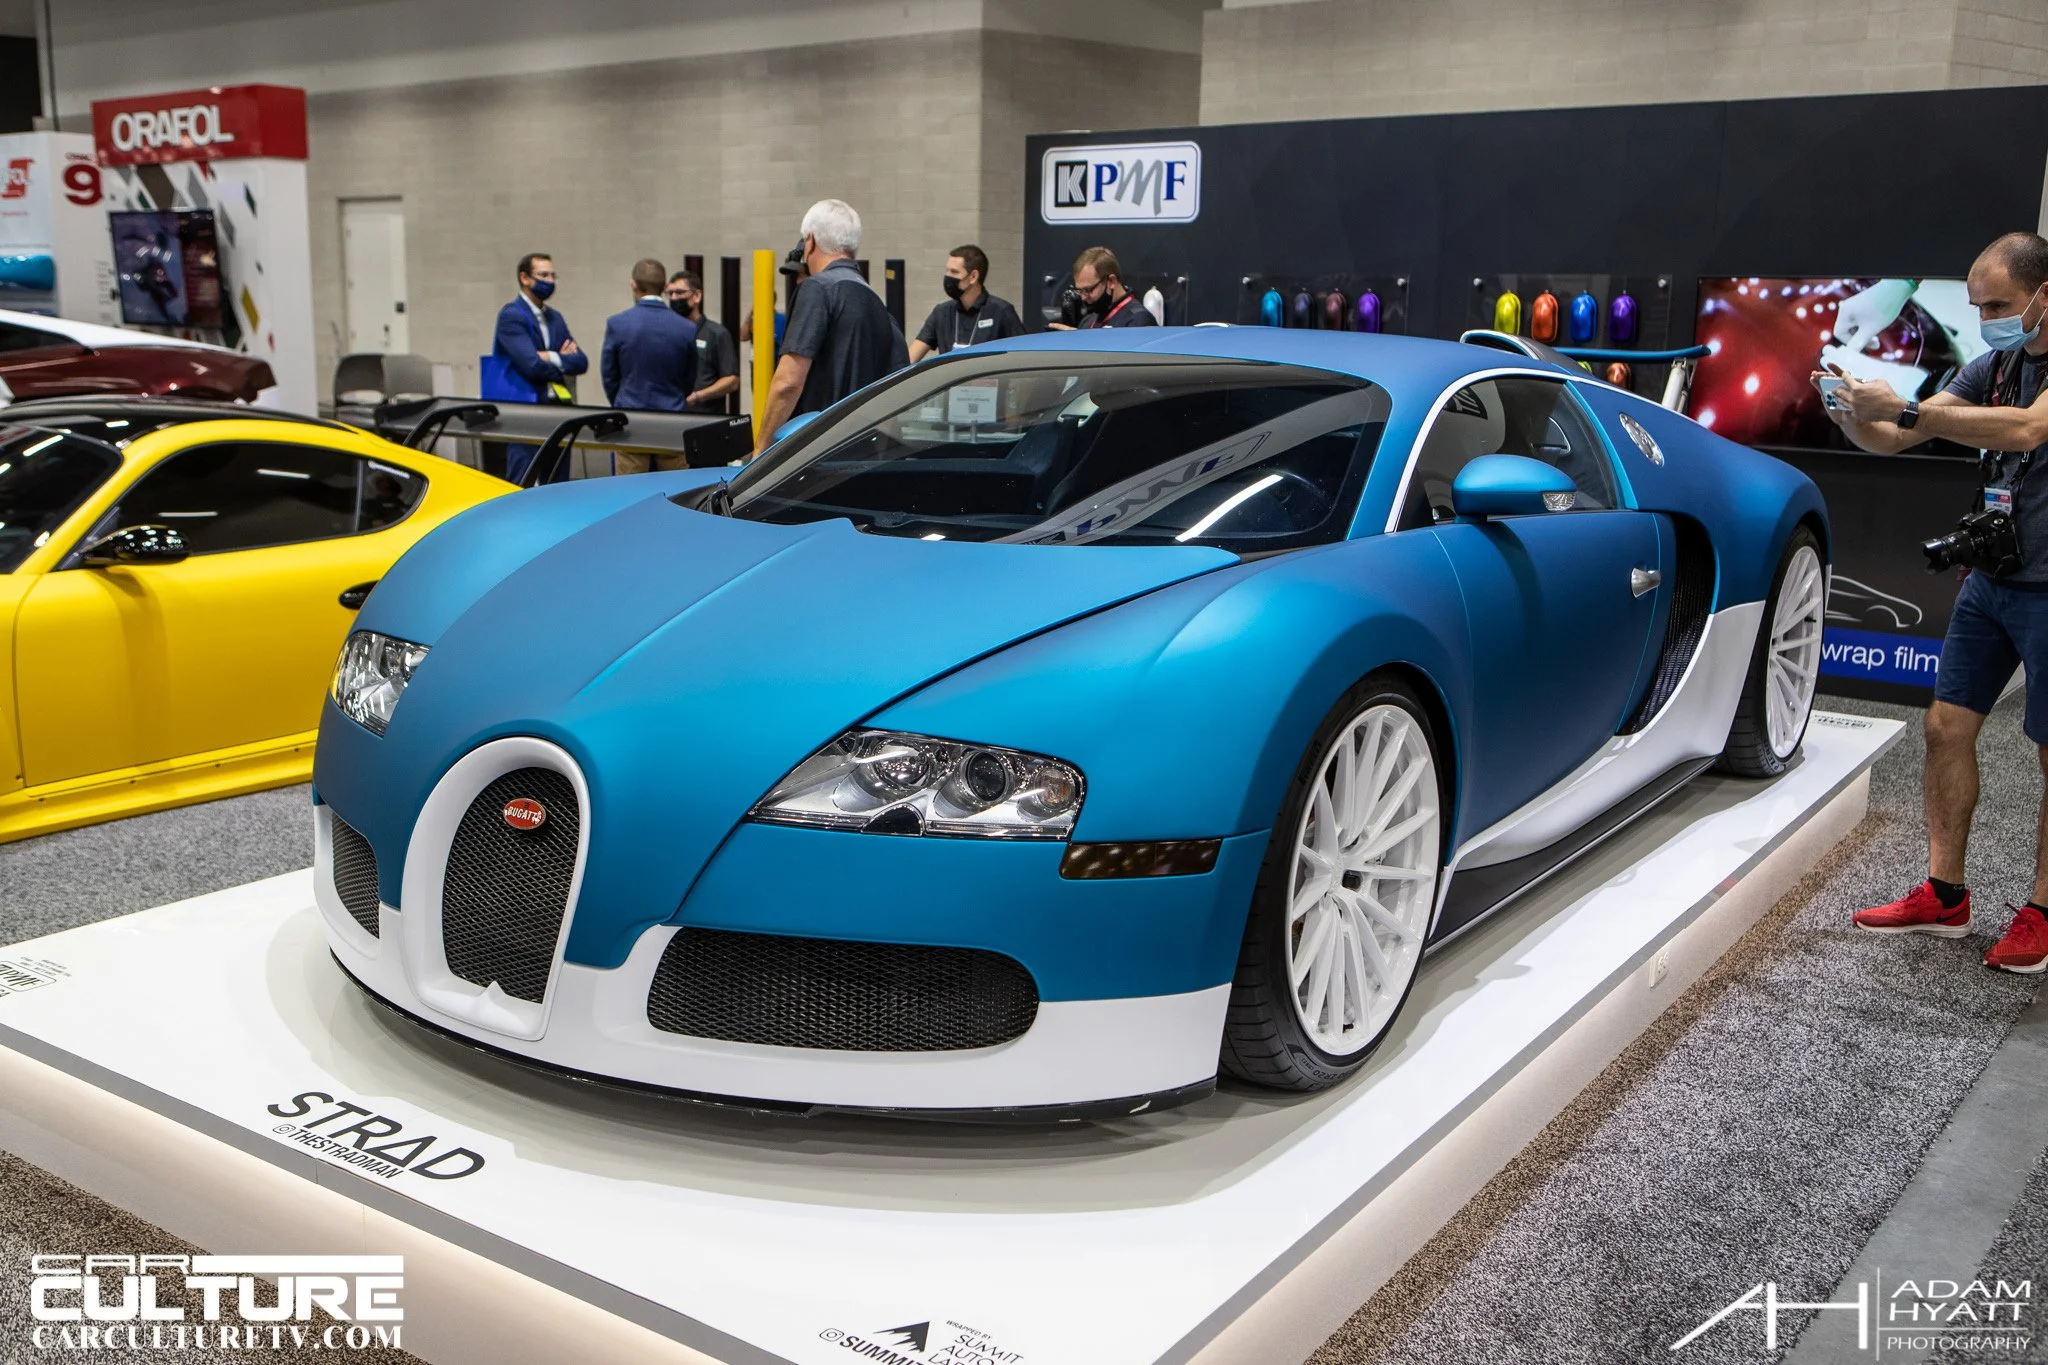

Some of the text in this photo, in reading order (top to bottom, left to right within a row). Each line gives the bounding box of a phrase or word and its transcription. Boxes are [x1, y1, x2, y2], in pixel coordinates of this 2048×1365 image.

[112, 104, 234, 152] ORAFOL
[1055, 158, 1187, 216] KPMF
[1822, 643, 1939, 674] wrap film
[267, 1091, 485, 1180] STRAD
[288, 1128, 404, 1179] THESTRADMAN
[946, 1320, 981, 1337] WRAPPED
[839, 1336, 923, 1365] SUMM
[954, 1334, 1024, 1364] SUMMIT
